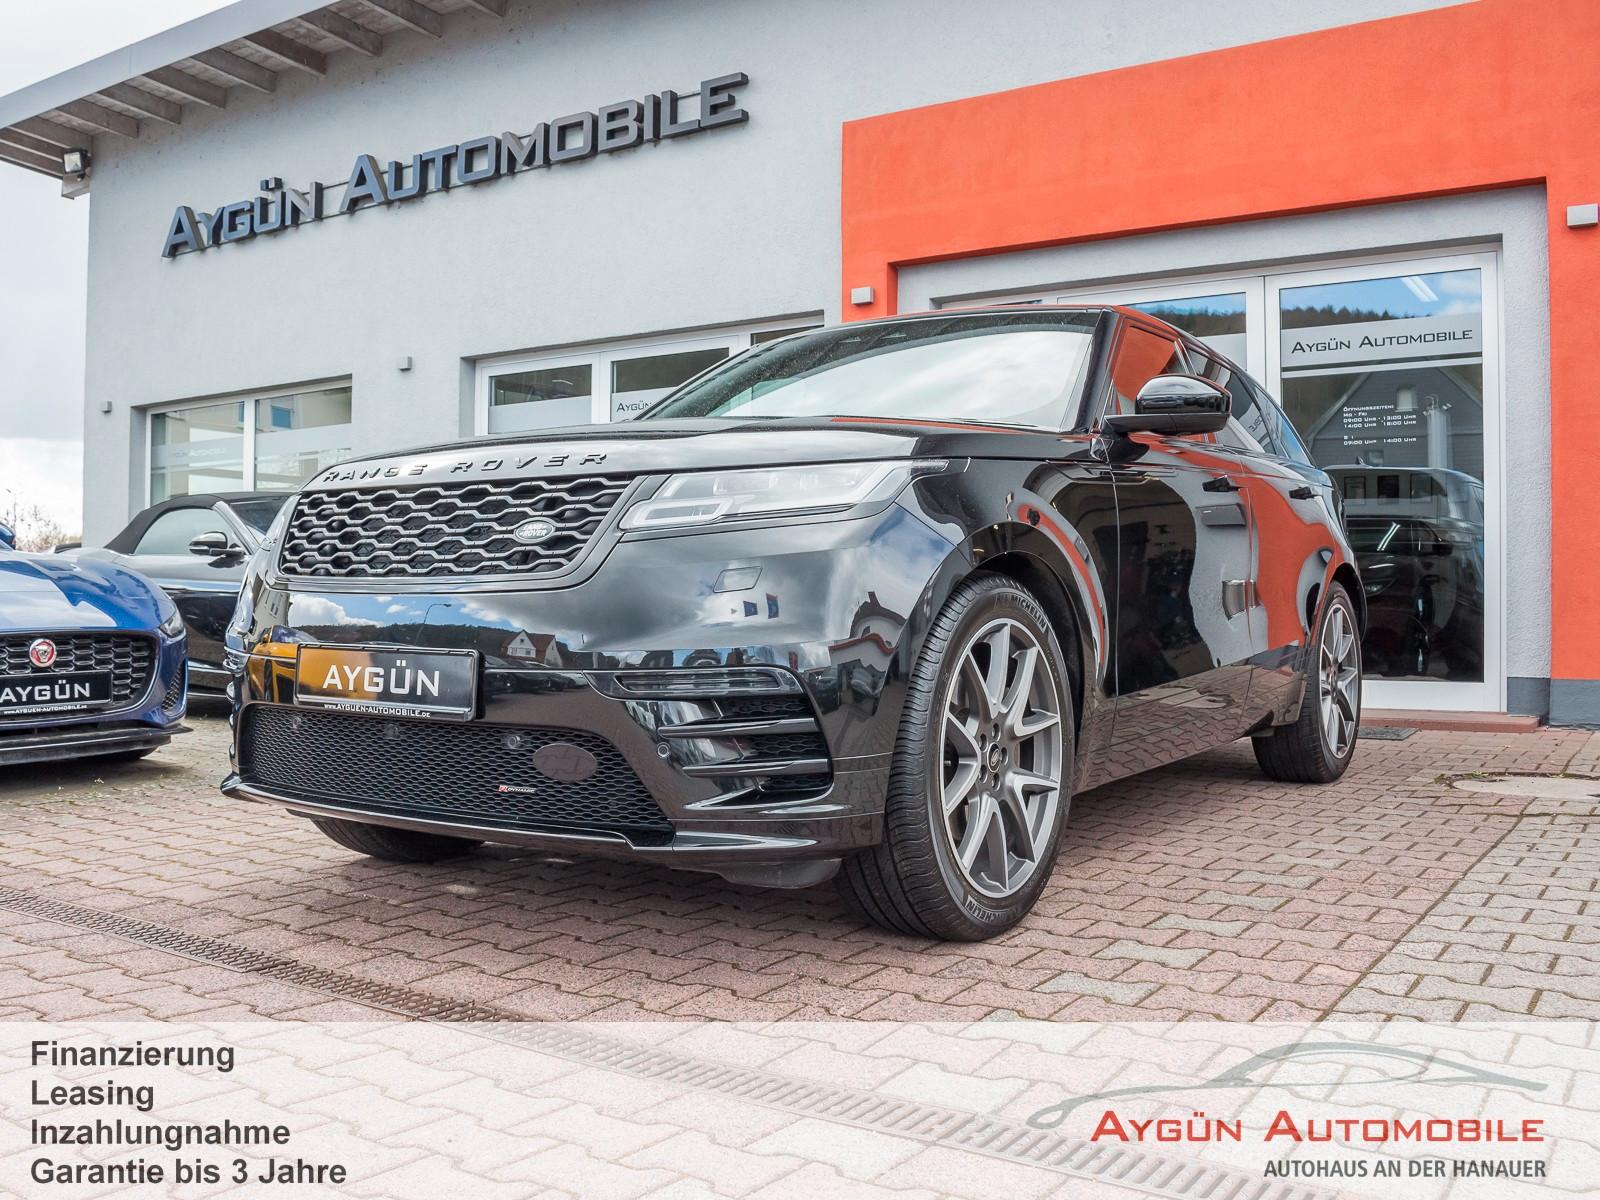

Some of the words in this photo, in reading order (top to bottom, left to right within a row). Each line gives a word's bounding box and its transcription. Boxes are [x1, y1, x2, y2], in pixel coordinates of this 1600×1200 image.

[161, 177, 323, 257] AYGÜN
[340, 72, 749, 213] AUTOMOBILE
[1291, 337, 1351, 354] AYGÜN
[1359, 329, 1473, 348] AUTOMOBILE
[323, 464, 429, 482] RANGE
[450, 454, 608, 473] ROVER
[1011, 593, 1047, 631] MICHELIN
[0, 679, 91, 703] AYGÜN
[322, 659, 440, 697] AYGÜN
